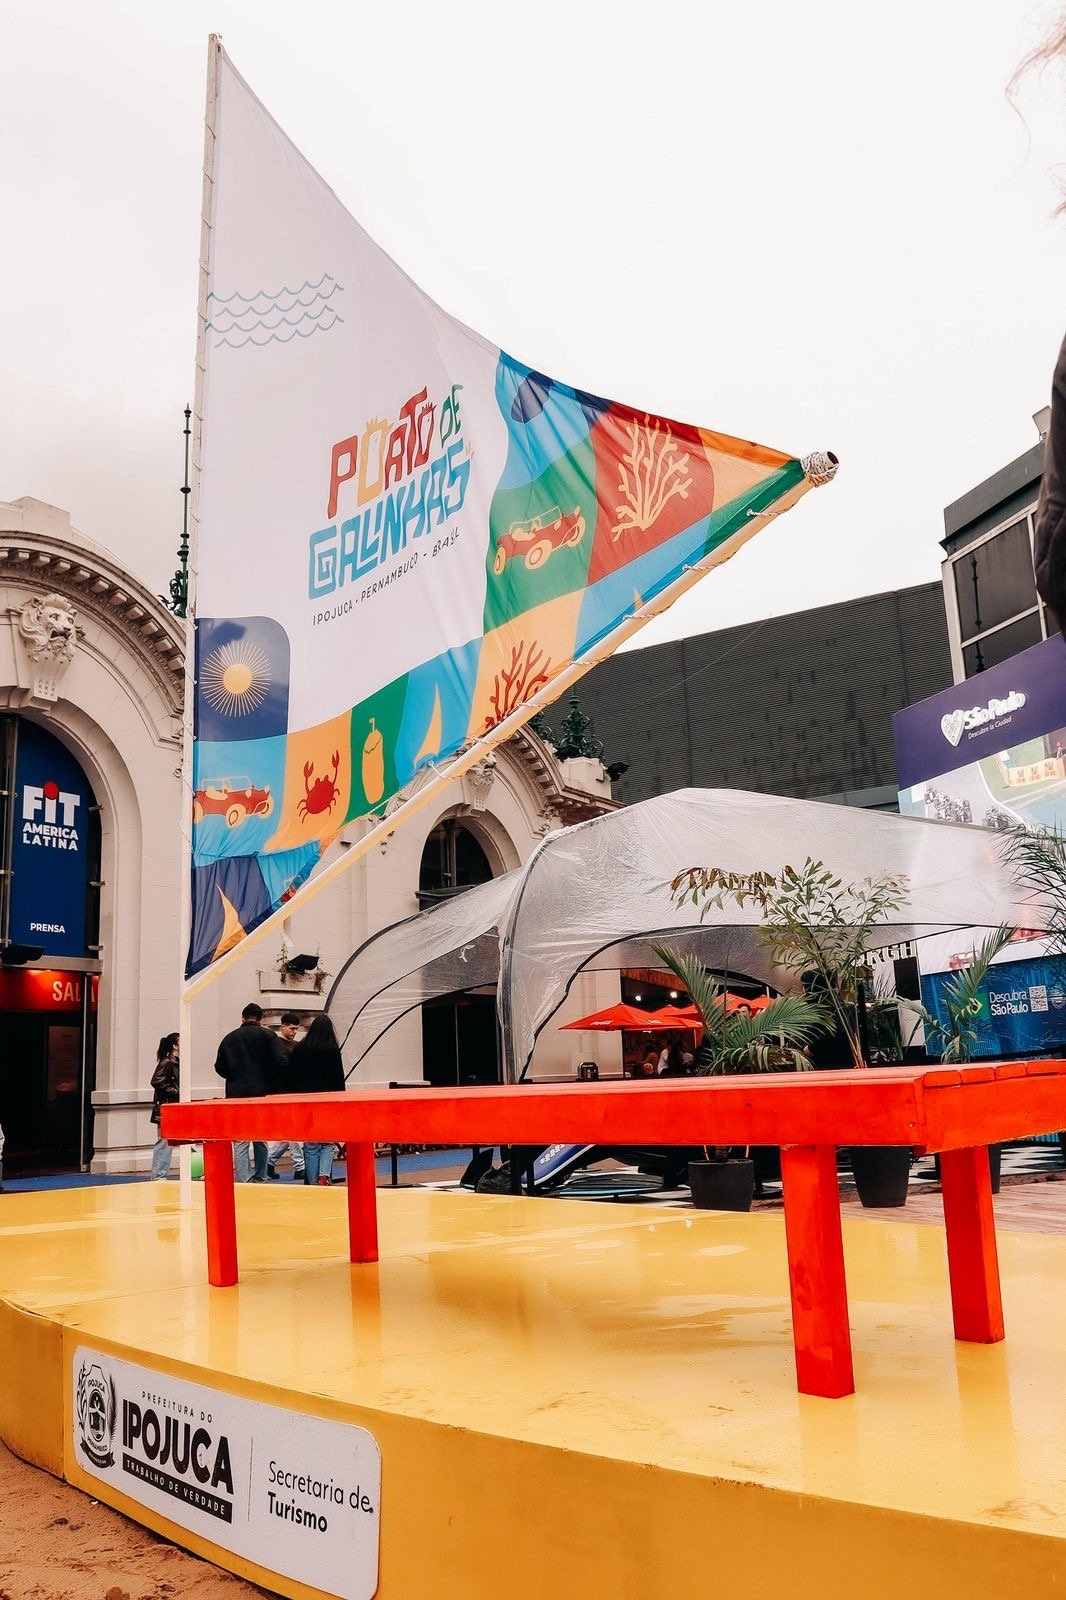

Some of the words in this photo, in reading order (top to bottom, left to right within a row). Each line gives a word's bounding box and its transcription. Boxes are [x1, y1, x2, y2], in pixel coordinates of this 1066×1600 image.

[328, 386, 437, 519] PORTO
[440, 384, 463, 448] DE
[308, 438, 470, 599] GALINHAS
[312, 600, 353, 626] IPOJUCA
[361, 552, 418, 602] PERNAMBUCO
[23, 822, 79, 841] AMERICA
[23, 833, 78, 851] LATINA
[30, 922, 65, 934] PRENSA
[989, 989, 1027, 1004] Descubra
[142, 1390, 194, 1417] PREFEITURA
[200, 1411, 212, 1423] DO
[123, 1399, 234, 1495] IPOJUCA
[127, 1460, 164, 1485] TRABALHO
[168, 1481, 179, 1493] DE
[183, 1488, 225, 1515] VERDADE
[269, 1460, 344, 1505] Secretaria
[267, 1491, 328, 1532] Turismo
